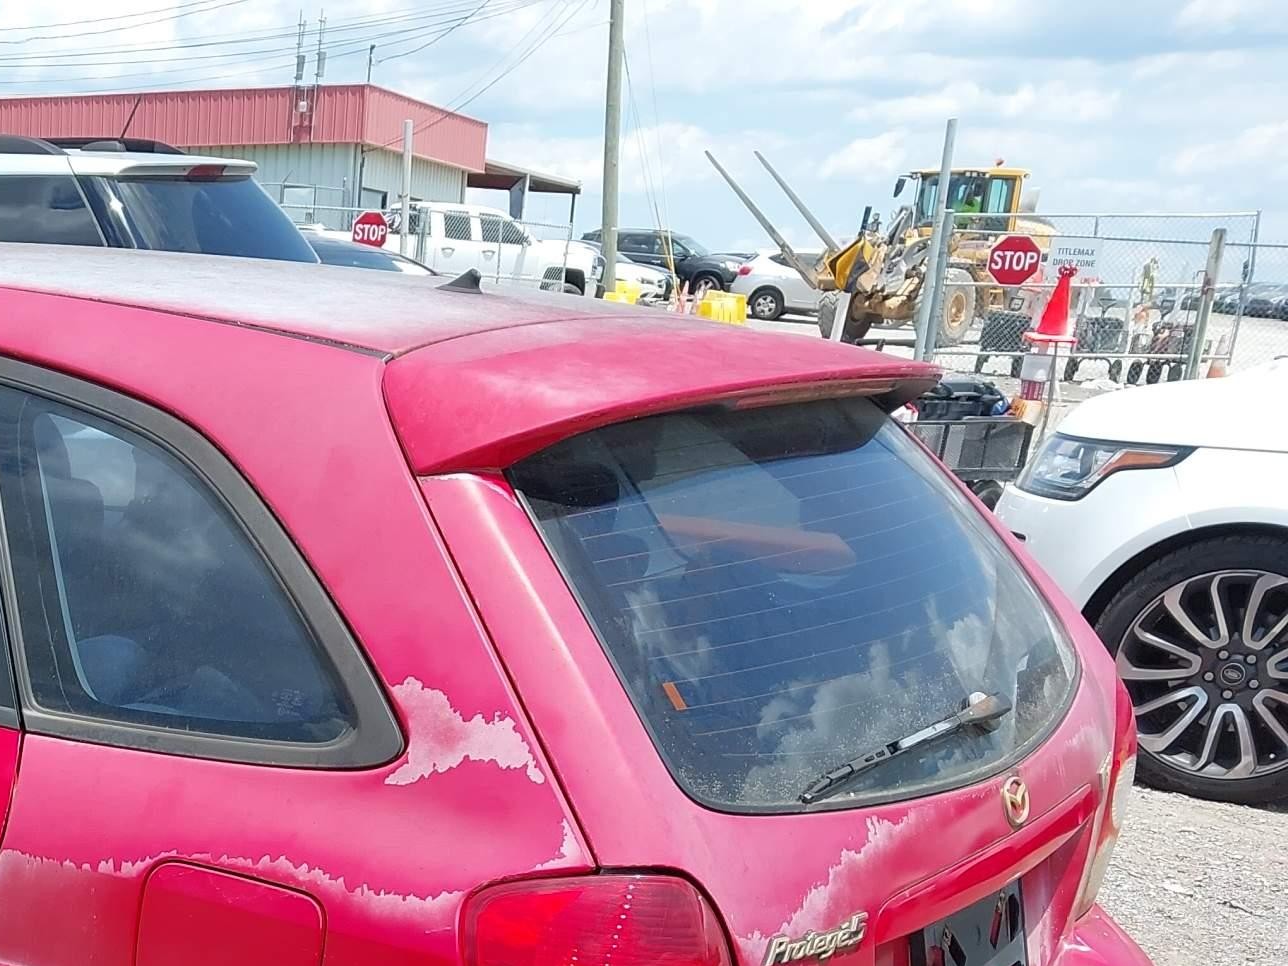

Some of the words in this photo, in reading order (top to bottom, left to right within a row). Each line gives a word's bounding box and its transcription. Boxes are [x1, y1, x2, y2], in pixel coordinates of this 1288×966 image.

[354, 223, 387, 242] STOP
[1057, 247, 1096, 256] TITLEMAX
[991, 250, 1038, 271] STOP
[1053, 258, 1074, 267] DROP
[1074, 259, 1096, 268] ZONE
